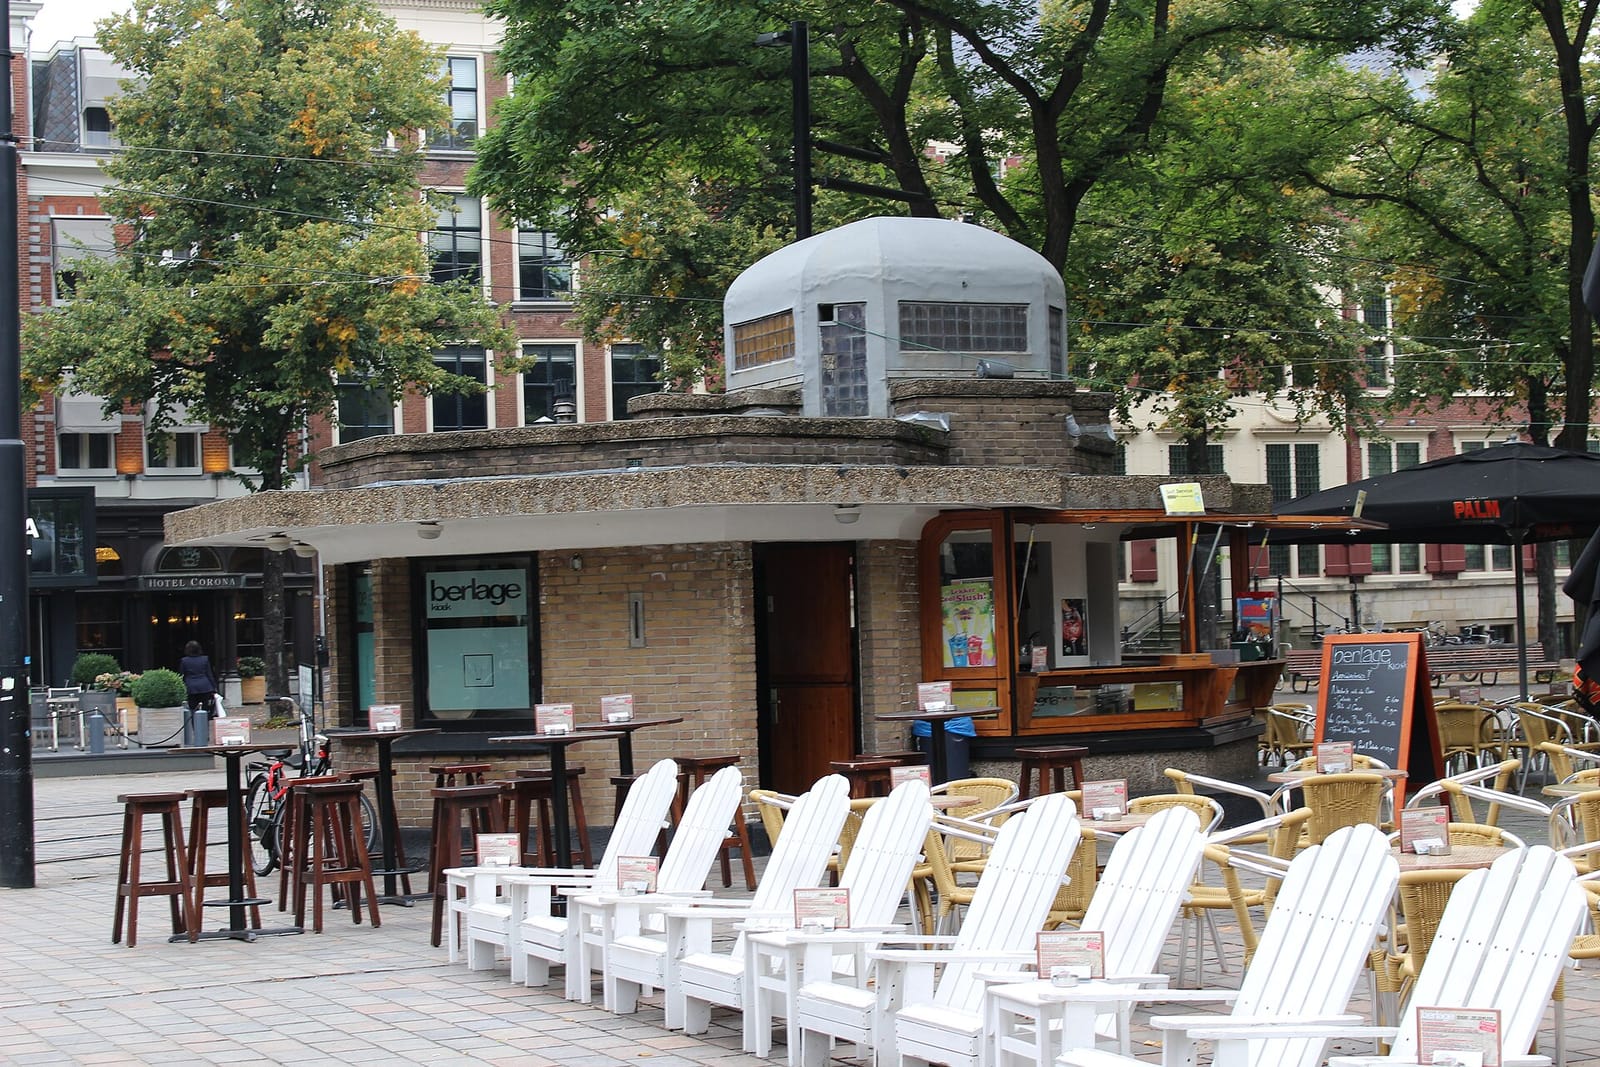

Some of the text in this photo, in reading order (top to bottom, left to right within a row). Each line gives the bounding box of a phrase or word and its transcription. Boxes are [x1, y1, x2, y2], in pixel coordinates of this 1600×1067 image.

[1452, 499, 1501, 520] PALM
[148, 577, 236, 588] HOTEL CORONA
[430, 577, 522, 606] berlage
[1333, 645, 1392, 670] berlage
